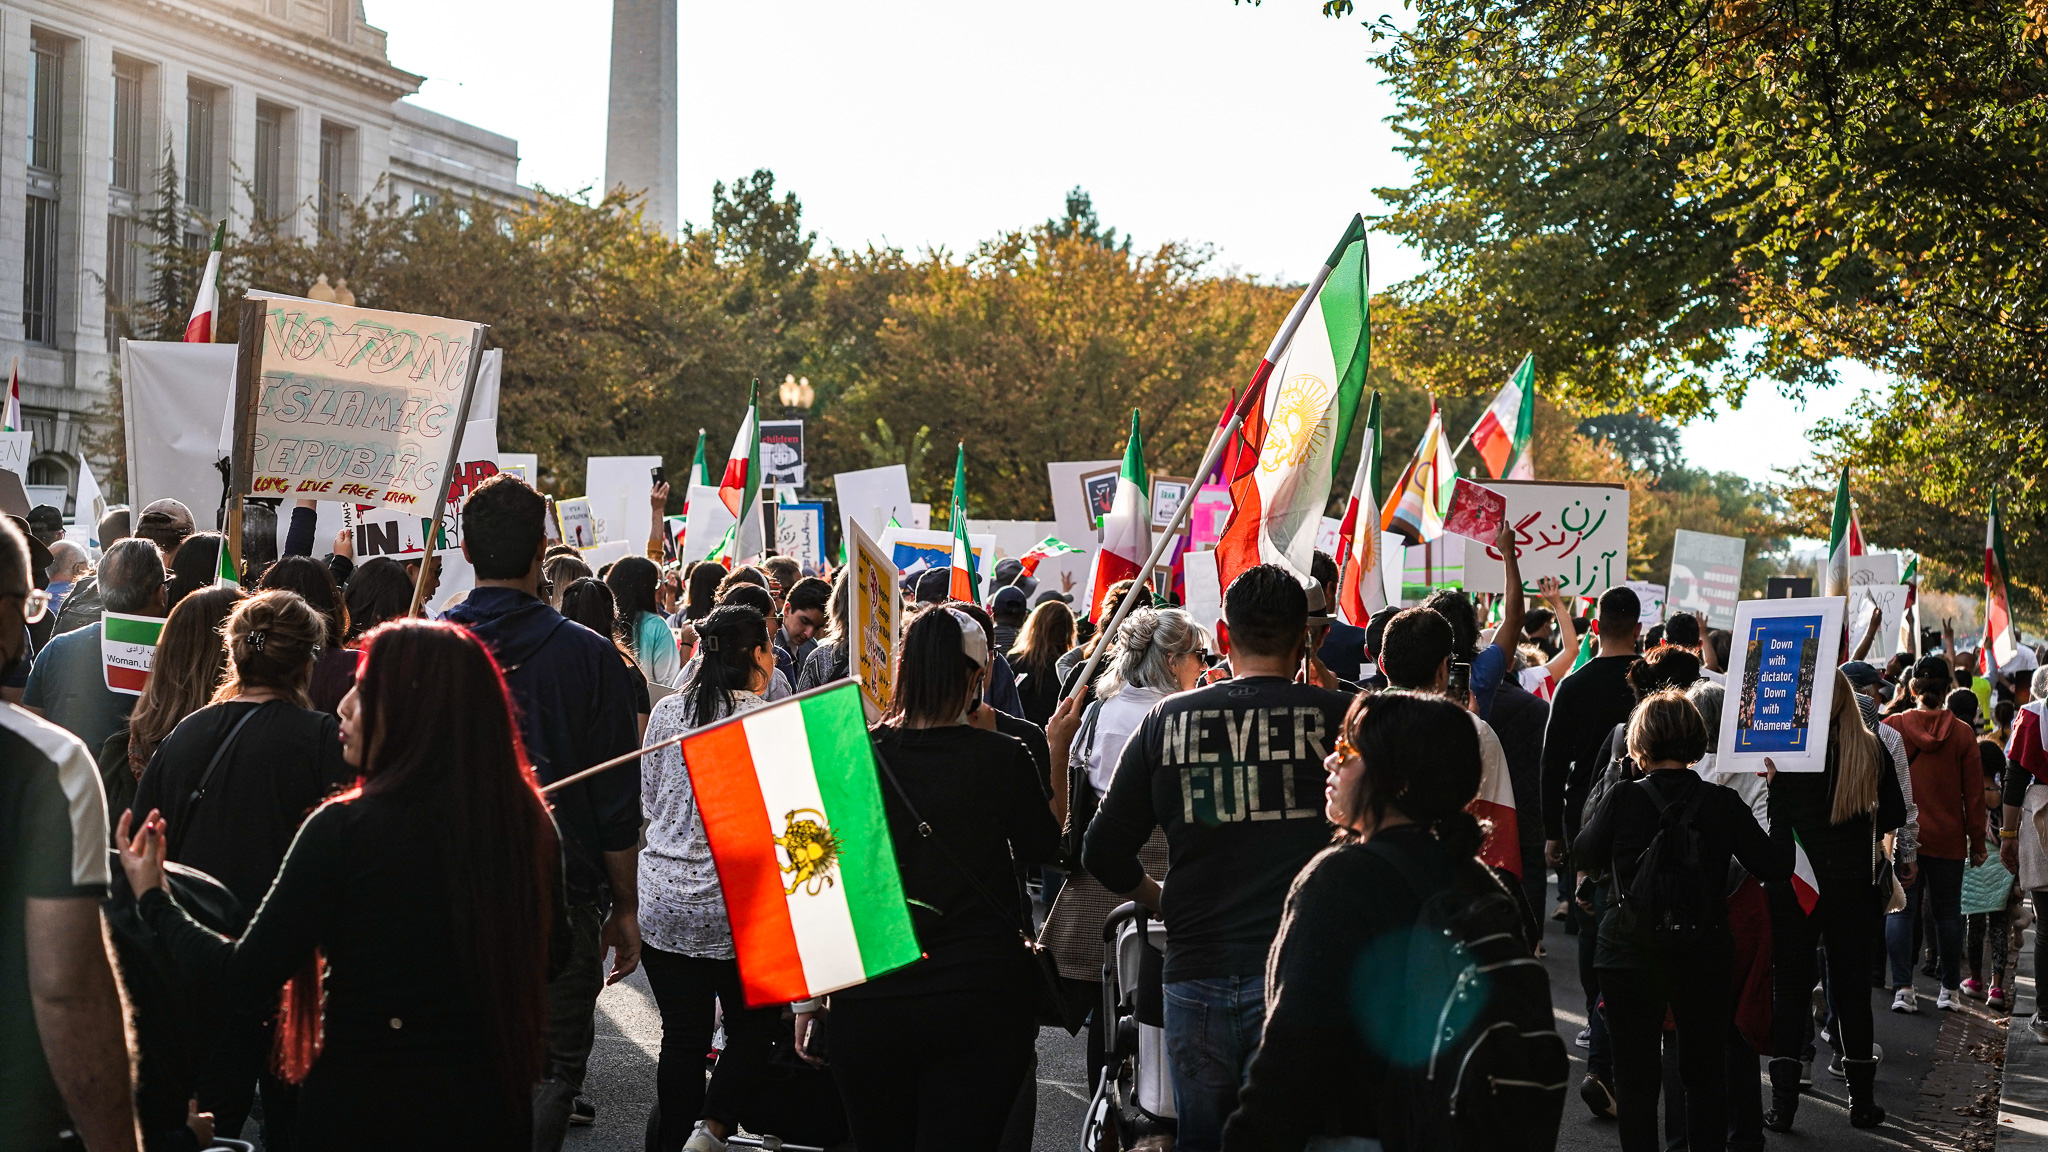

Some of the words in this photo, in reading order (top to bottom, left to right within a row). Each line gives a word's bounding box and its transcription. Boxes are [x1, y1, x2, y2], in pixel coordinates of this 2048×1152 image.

[252, 312, 326, 361] NO
[336, 323, 412, 374] TO
[252, 376, 448, 438] ISLAMIC
[762, 434, 799, 444] children
[246, 434, 439, 491] REPUBLIC
[253, 475, 290, 494] LONG
[296, 479, 333, 493] LIVE
[338, 483, 377, 500] FREE
[382, 490, 417, 505] IRAN
[1562, 495, 1611, 541] زن
[356, 520, 400, 556] IN
[1486, 511, 1583, 561] زندگی
[1522, 550, 1617, 596] آزادی
[107, 654, 142, 668] Woman,
[1769, 655, 1786, 666] with
[1771, 639, 1793, 650] Down
[1761, 671, 1794, 683] dictator,
[1764, 687, 1786, 698] Down
[1753, 719, 1792, 731] Khamenei
[1762, 703, 1780, 714] with
[1162, 707, 1329, 766] NEVER
[1180, 764, 1318, 823] FULL
